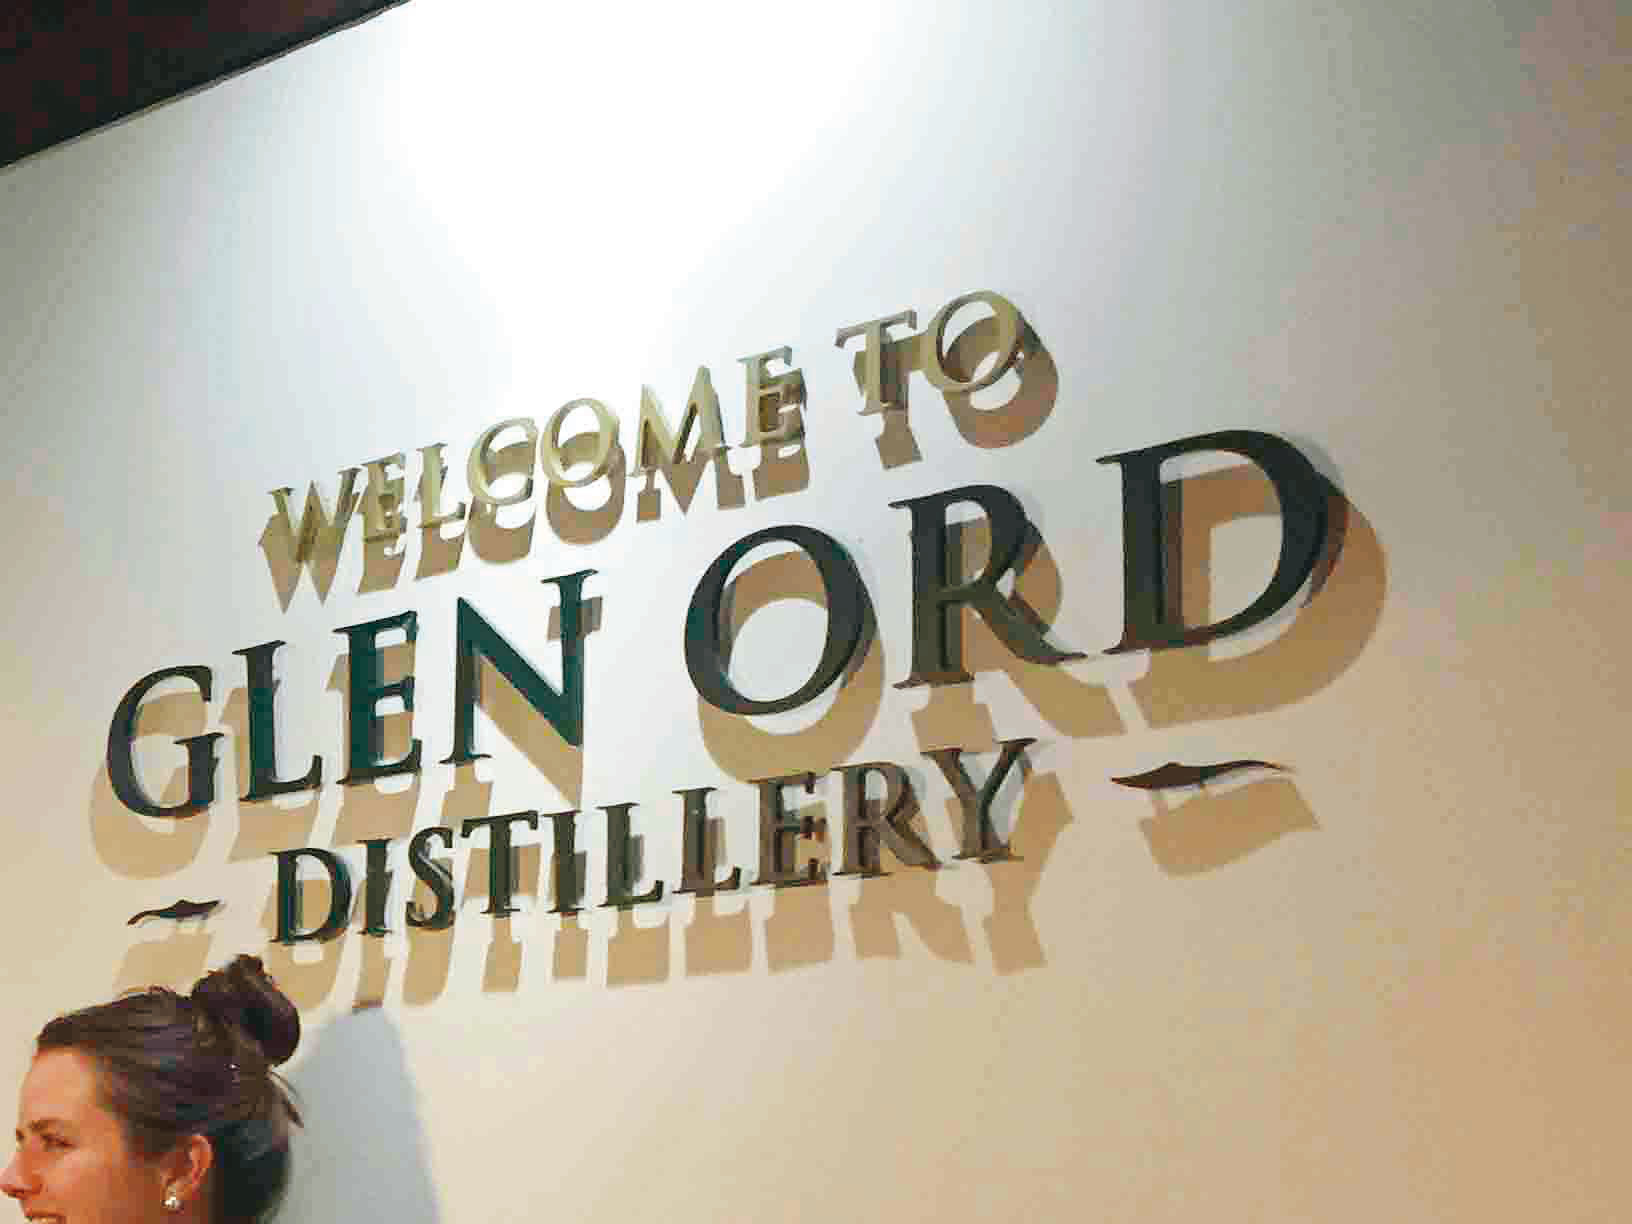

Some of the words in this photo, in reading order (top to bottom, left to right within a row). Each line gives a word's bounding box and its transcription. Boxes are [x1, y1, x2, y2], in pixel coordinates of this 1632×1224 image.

[268, 345, 795, 562] WELCOME
[835, 290, 1024, 415] TO
[106, 568, 598, 818] GLEN
[683, 429, 1348, 713] ORD
[272, 737, 1039, 943] DISTILLERY
